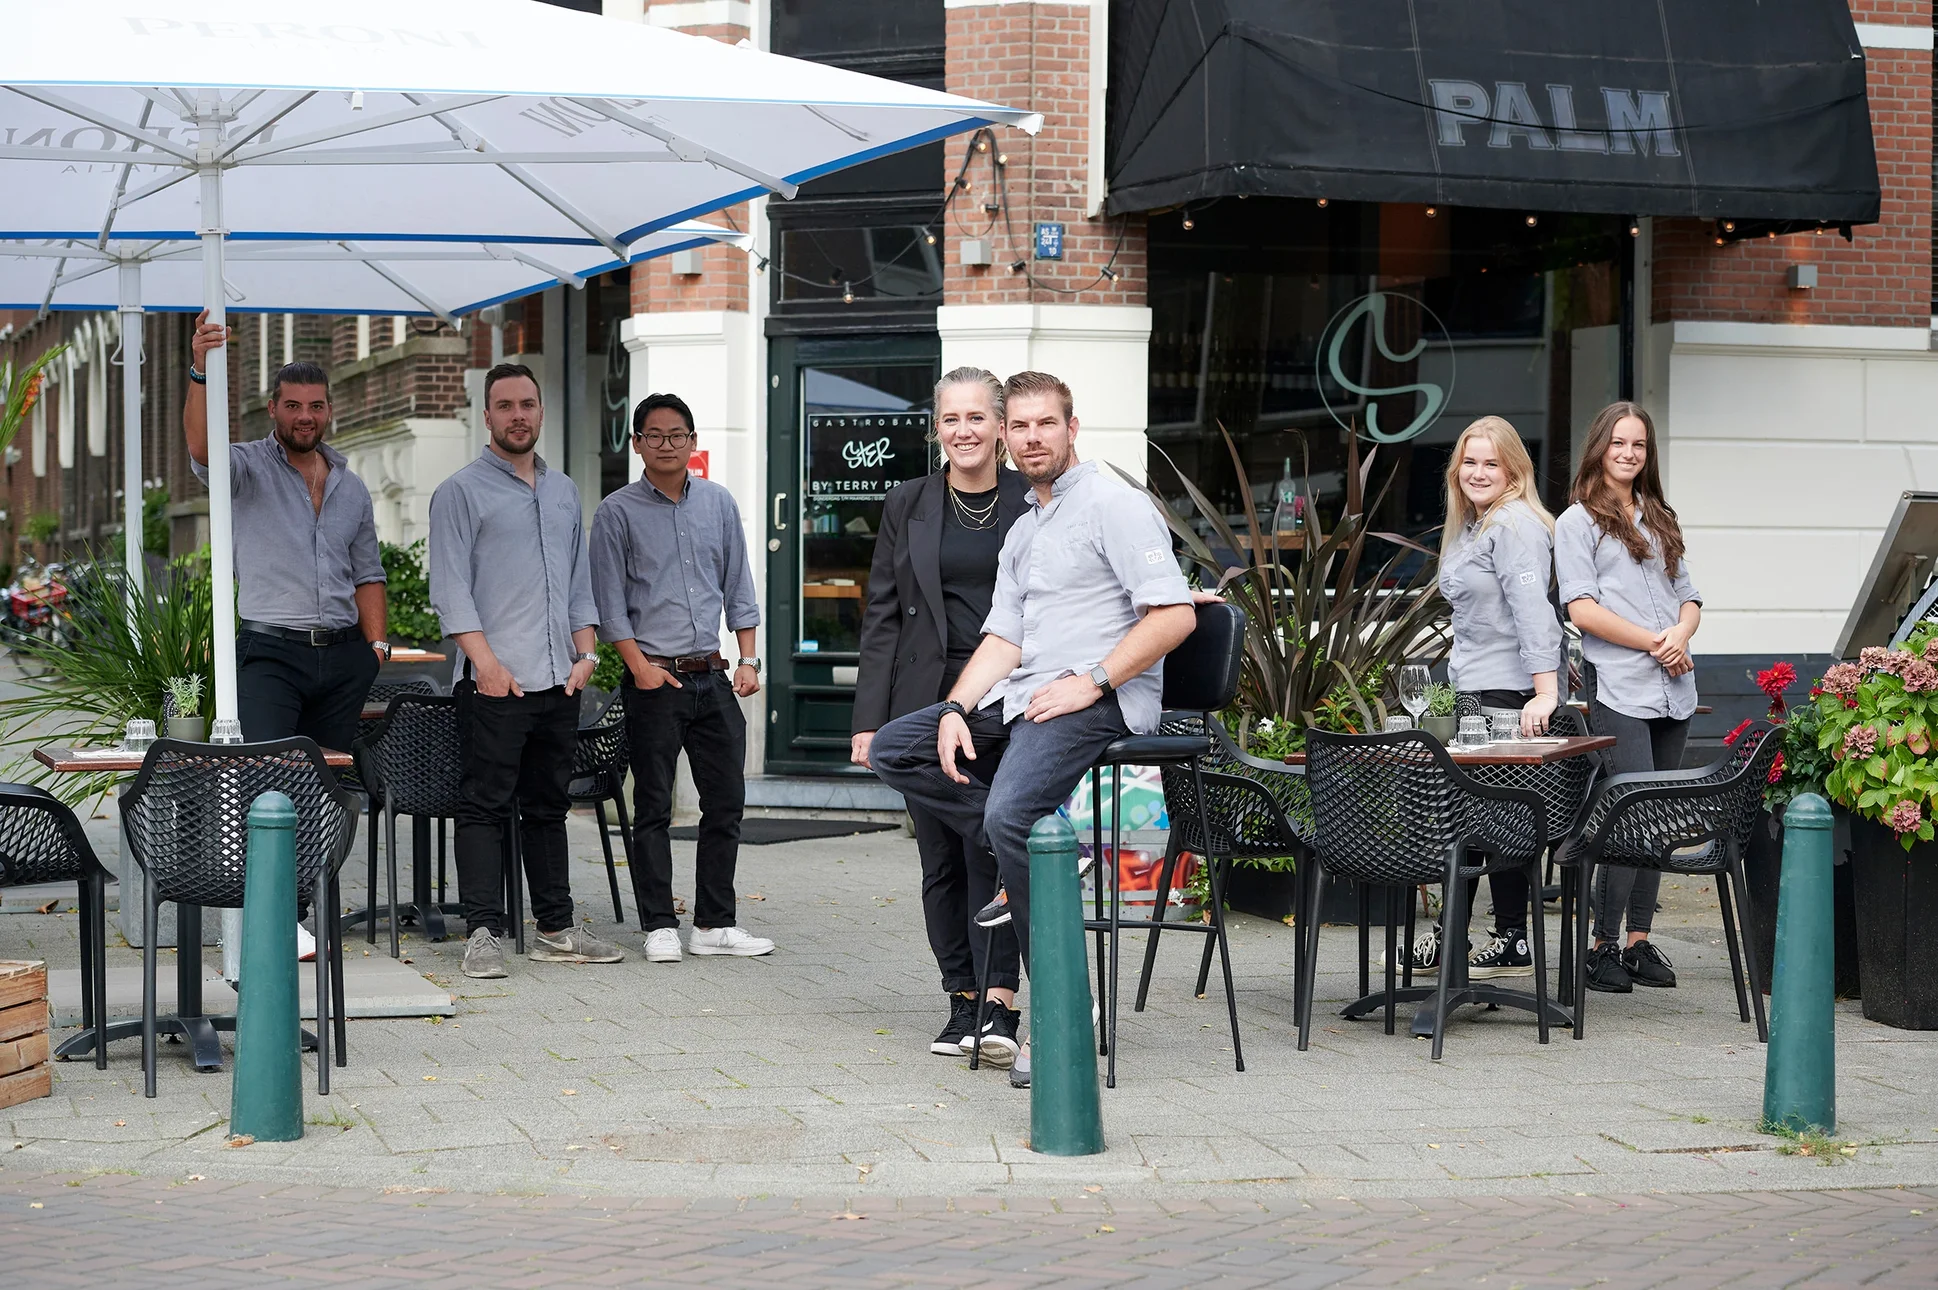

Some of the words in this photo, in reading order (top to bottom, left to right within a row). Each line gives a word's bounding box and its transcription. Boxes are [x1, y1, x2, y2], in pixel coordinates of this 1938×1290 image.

[120, 16, 488, 49] PERONI
[1428, 79, 1681, 157] PALM
[812, 418, 926, 427] GASTROBAR
[842, 437, 895, 469] STER
[812, 481, 828, 491] BY
[836, 481, 878, 490] TERRY
[885, 480, 906, 490] PR
